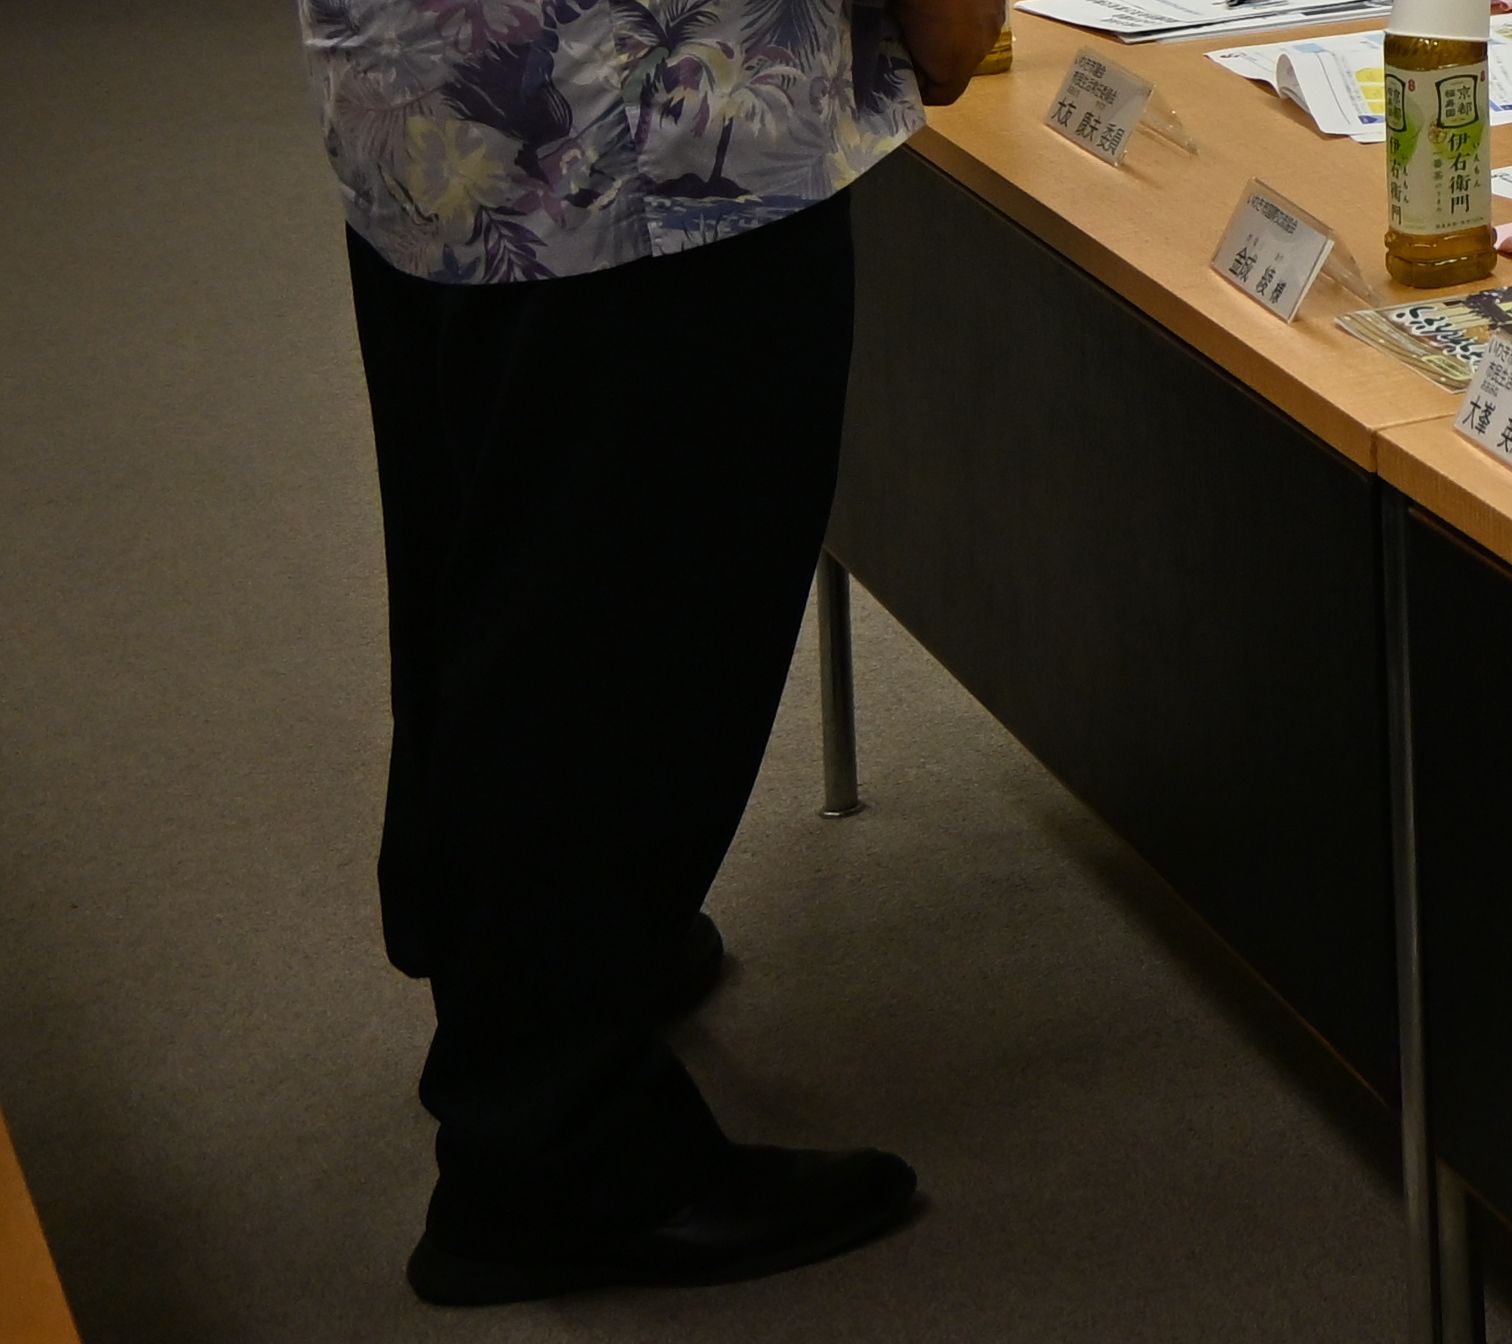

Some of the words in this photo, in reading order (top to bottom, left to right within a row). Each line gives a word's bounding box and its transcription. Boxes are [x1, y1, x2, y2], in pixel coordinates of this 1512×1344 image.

[1457, 85, 1473, 116] 京都
[1096, 123, 1125, 156] 委員
[1389, 135, 1403, 225] 伊右衛門
[1449, 132, 1471, 214] 伊右衛門
[1473, 140, 1481, 189] いえもん
[1462, 395, 1496, 436] 大峯
